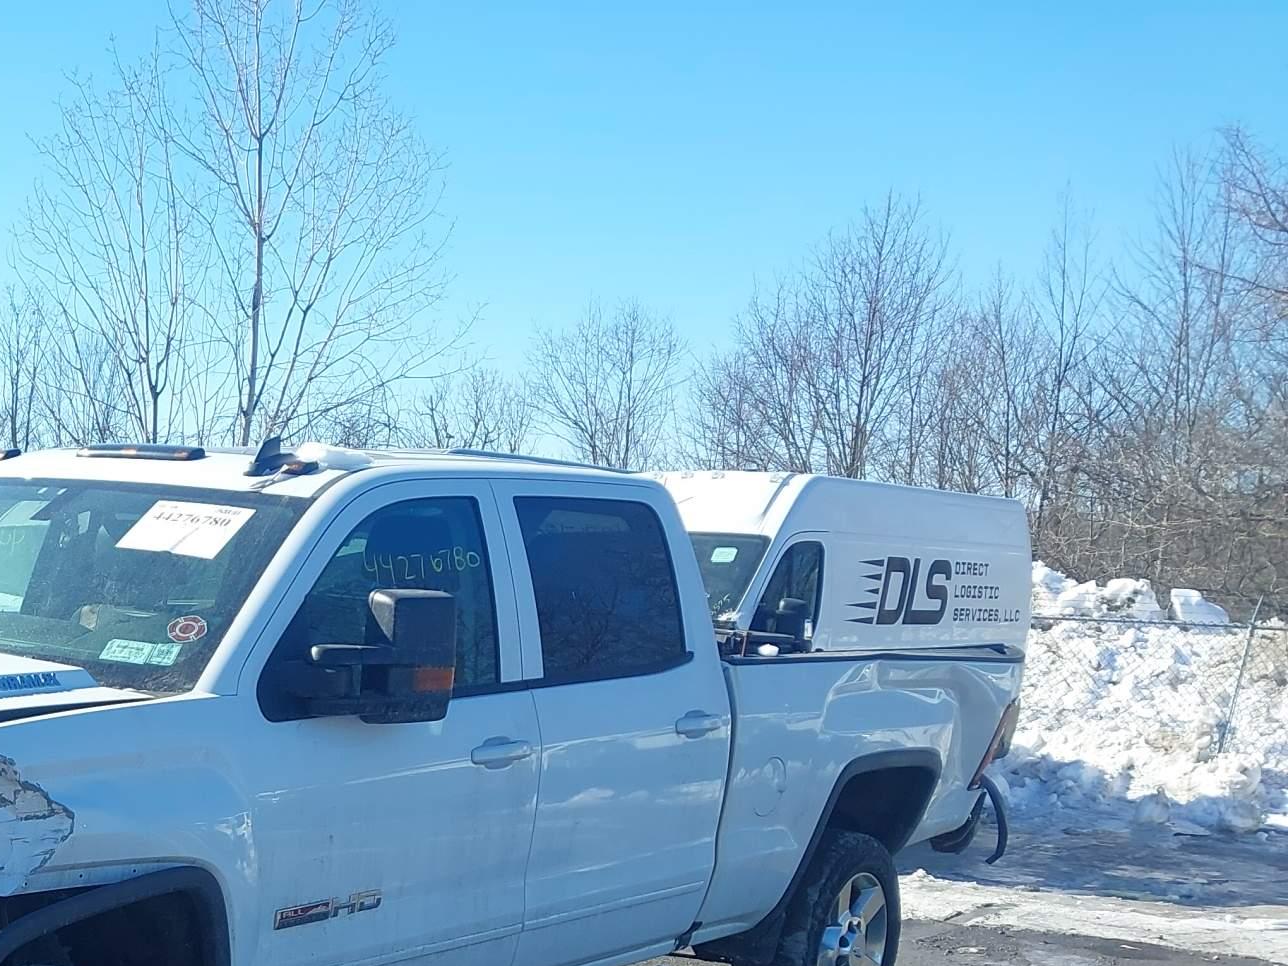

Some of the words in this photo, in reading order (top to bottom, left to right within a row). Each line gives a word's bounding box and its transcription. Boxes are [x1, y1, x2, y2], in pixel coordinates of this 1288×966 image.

[153, 511, 232, 527] 44276780
[363, 546, 480, 585] 44276780
[955, 561, 989, 576] DIRECT
[875, 556, 952, 625] DLS
[954, 585, 999, 599] LOGISTIC
[953, 607, 1001, 623] SERVICES,
[1003, 608, 1020, 622] LLC
